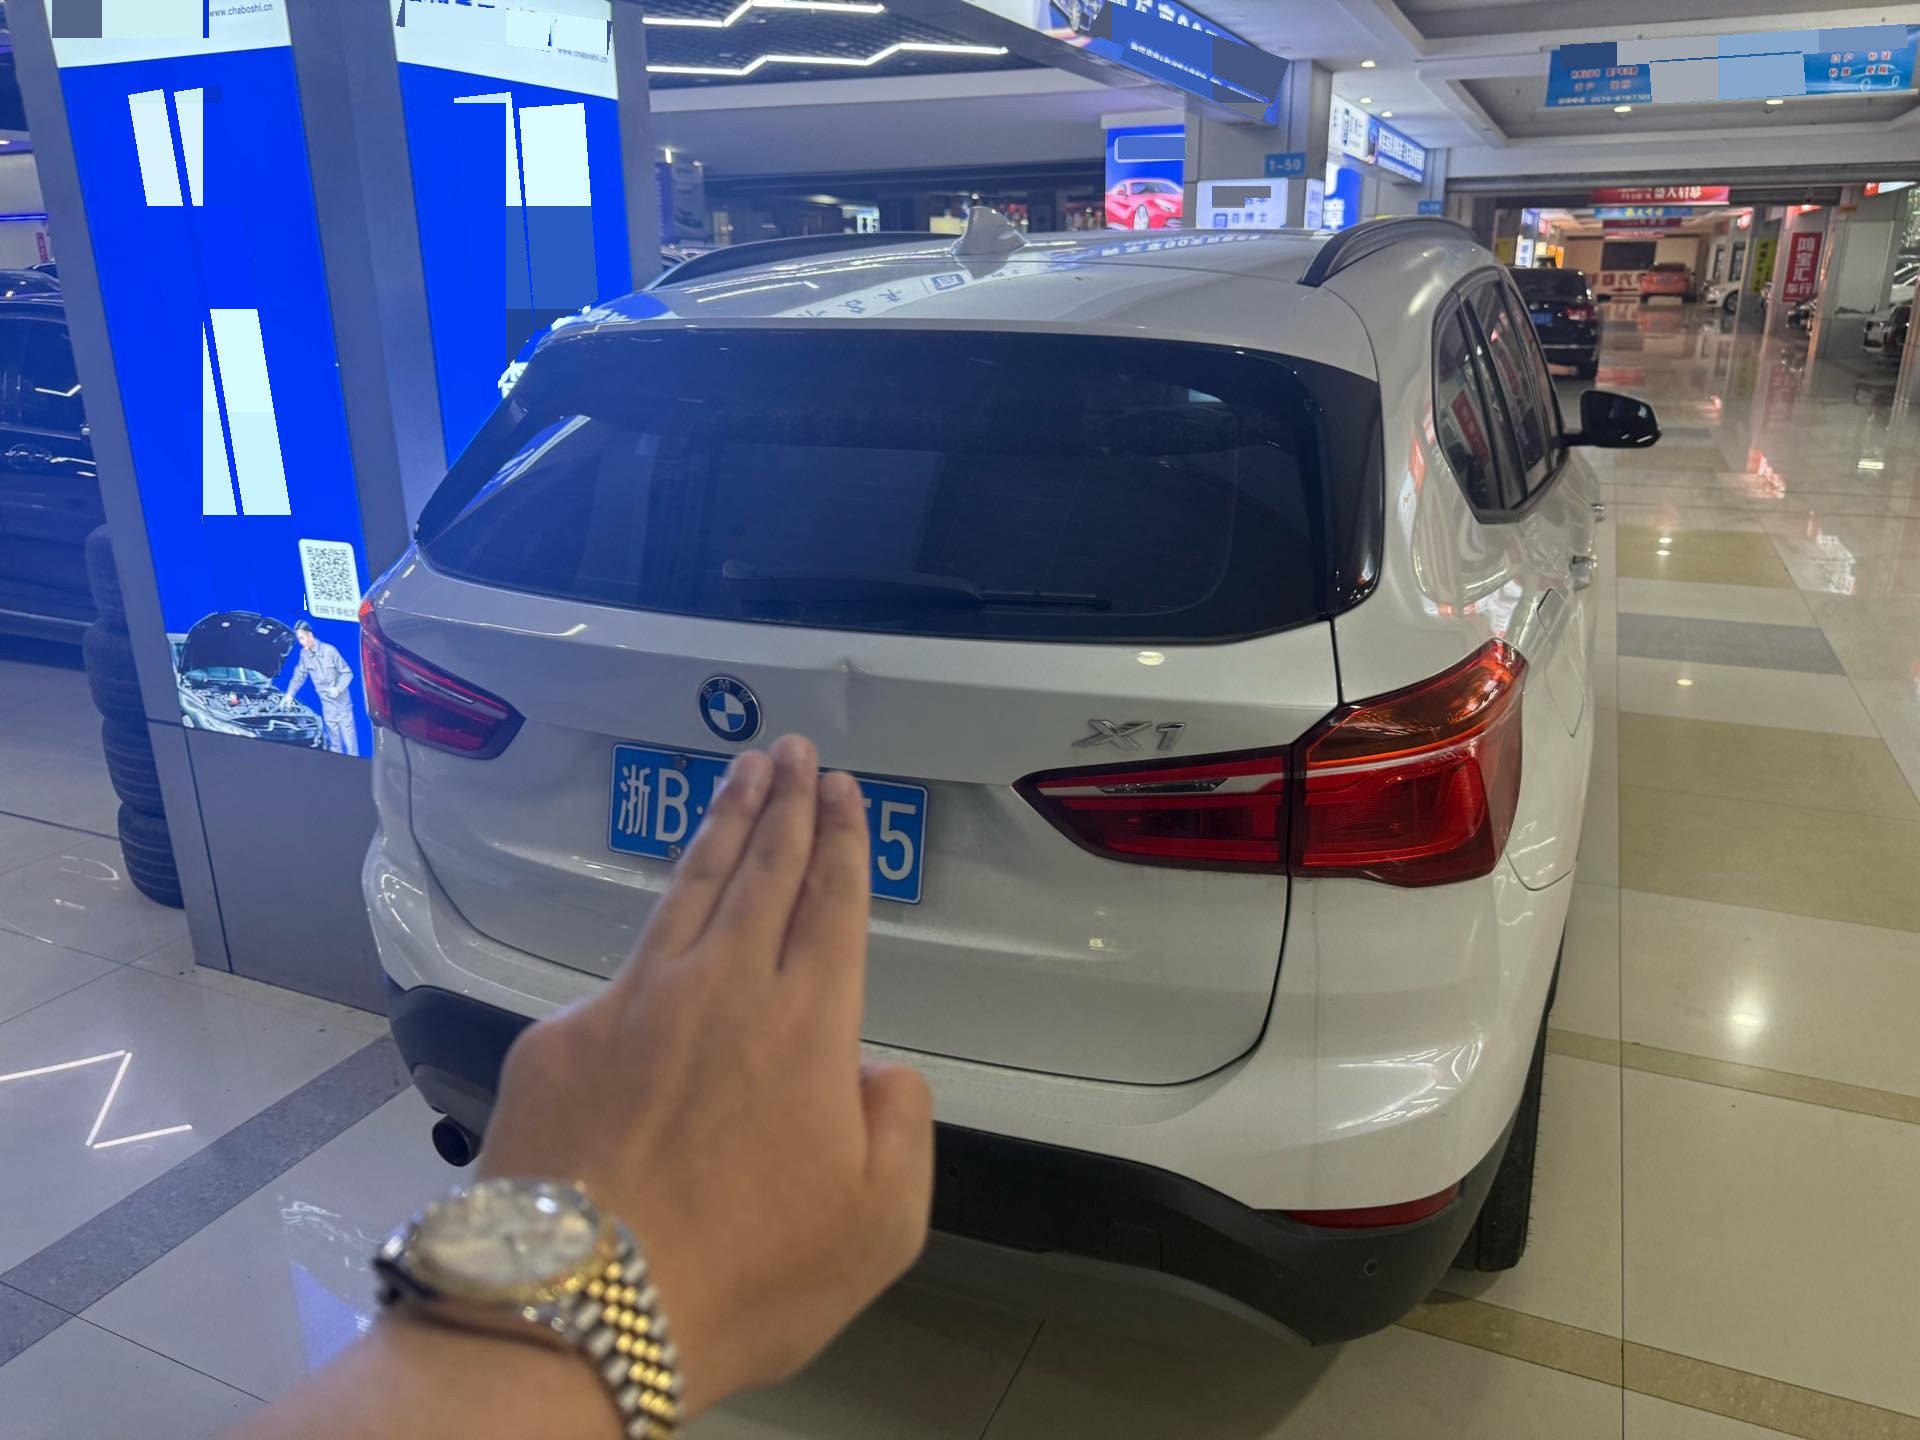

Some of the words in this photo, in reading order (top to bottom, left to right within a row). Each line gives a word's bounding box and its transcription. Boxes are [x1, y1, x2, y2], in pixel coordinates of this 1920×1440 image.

[209, 3, 273, 17] www.chaboshi.cn
[1268, 158, 1302, 173] 1-50
[702, 679, 753, 704] BMW
[1070, 717, 1185, 751] X1
